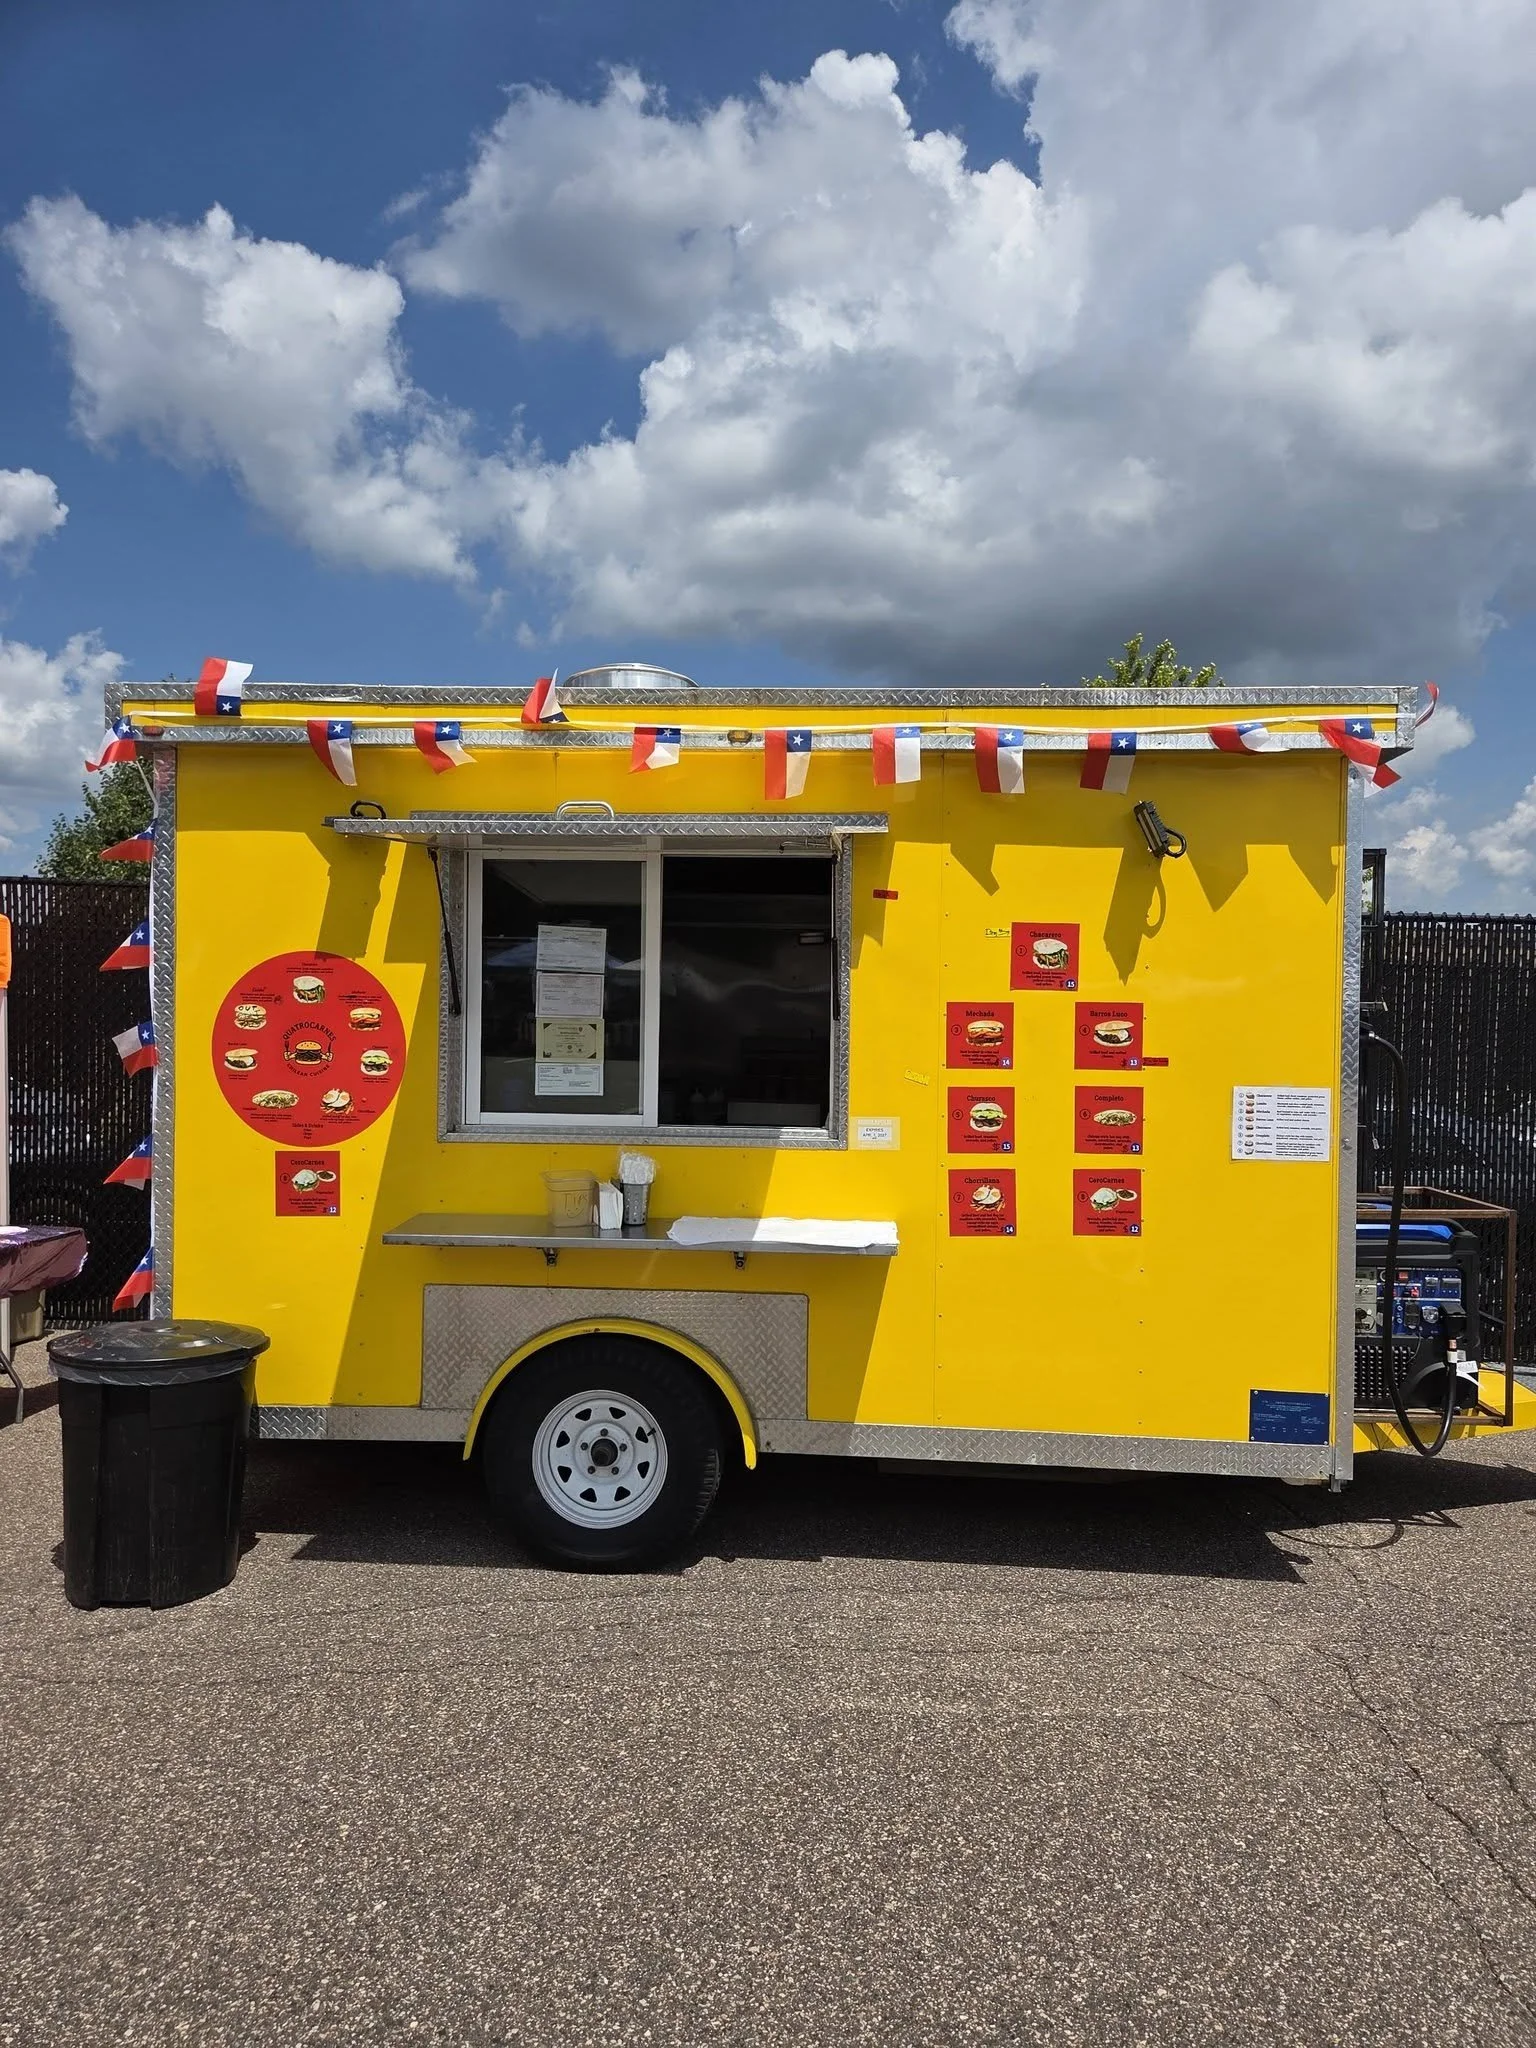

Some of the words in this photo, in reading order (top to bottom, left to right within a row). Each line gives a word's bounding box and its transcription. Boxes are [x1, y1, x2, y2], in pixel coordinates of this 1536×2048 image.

[1029, 931, 1062, 939] Chacarero
[1089, 1010, 1111, 1018] Barros
[1112, 1010, 1128, 1018] Luco
[282, 1021, 336, 1042] QUATROCARNES
[1094, 1094, 1124, 1102] Completo
[1132, 1144, 1140, 1152] 13
